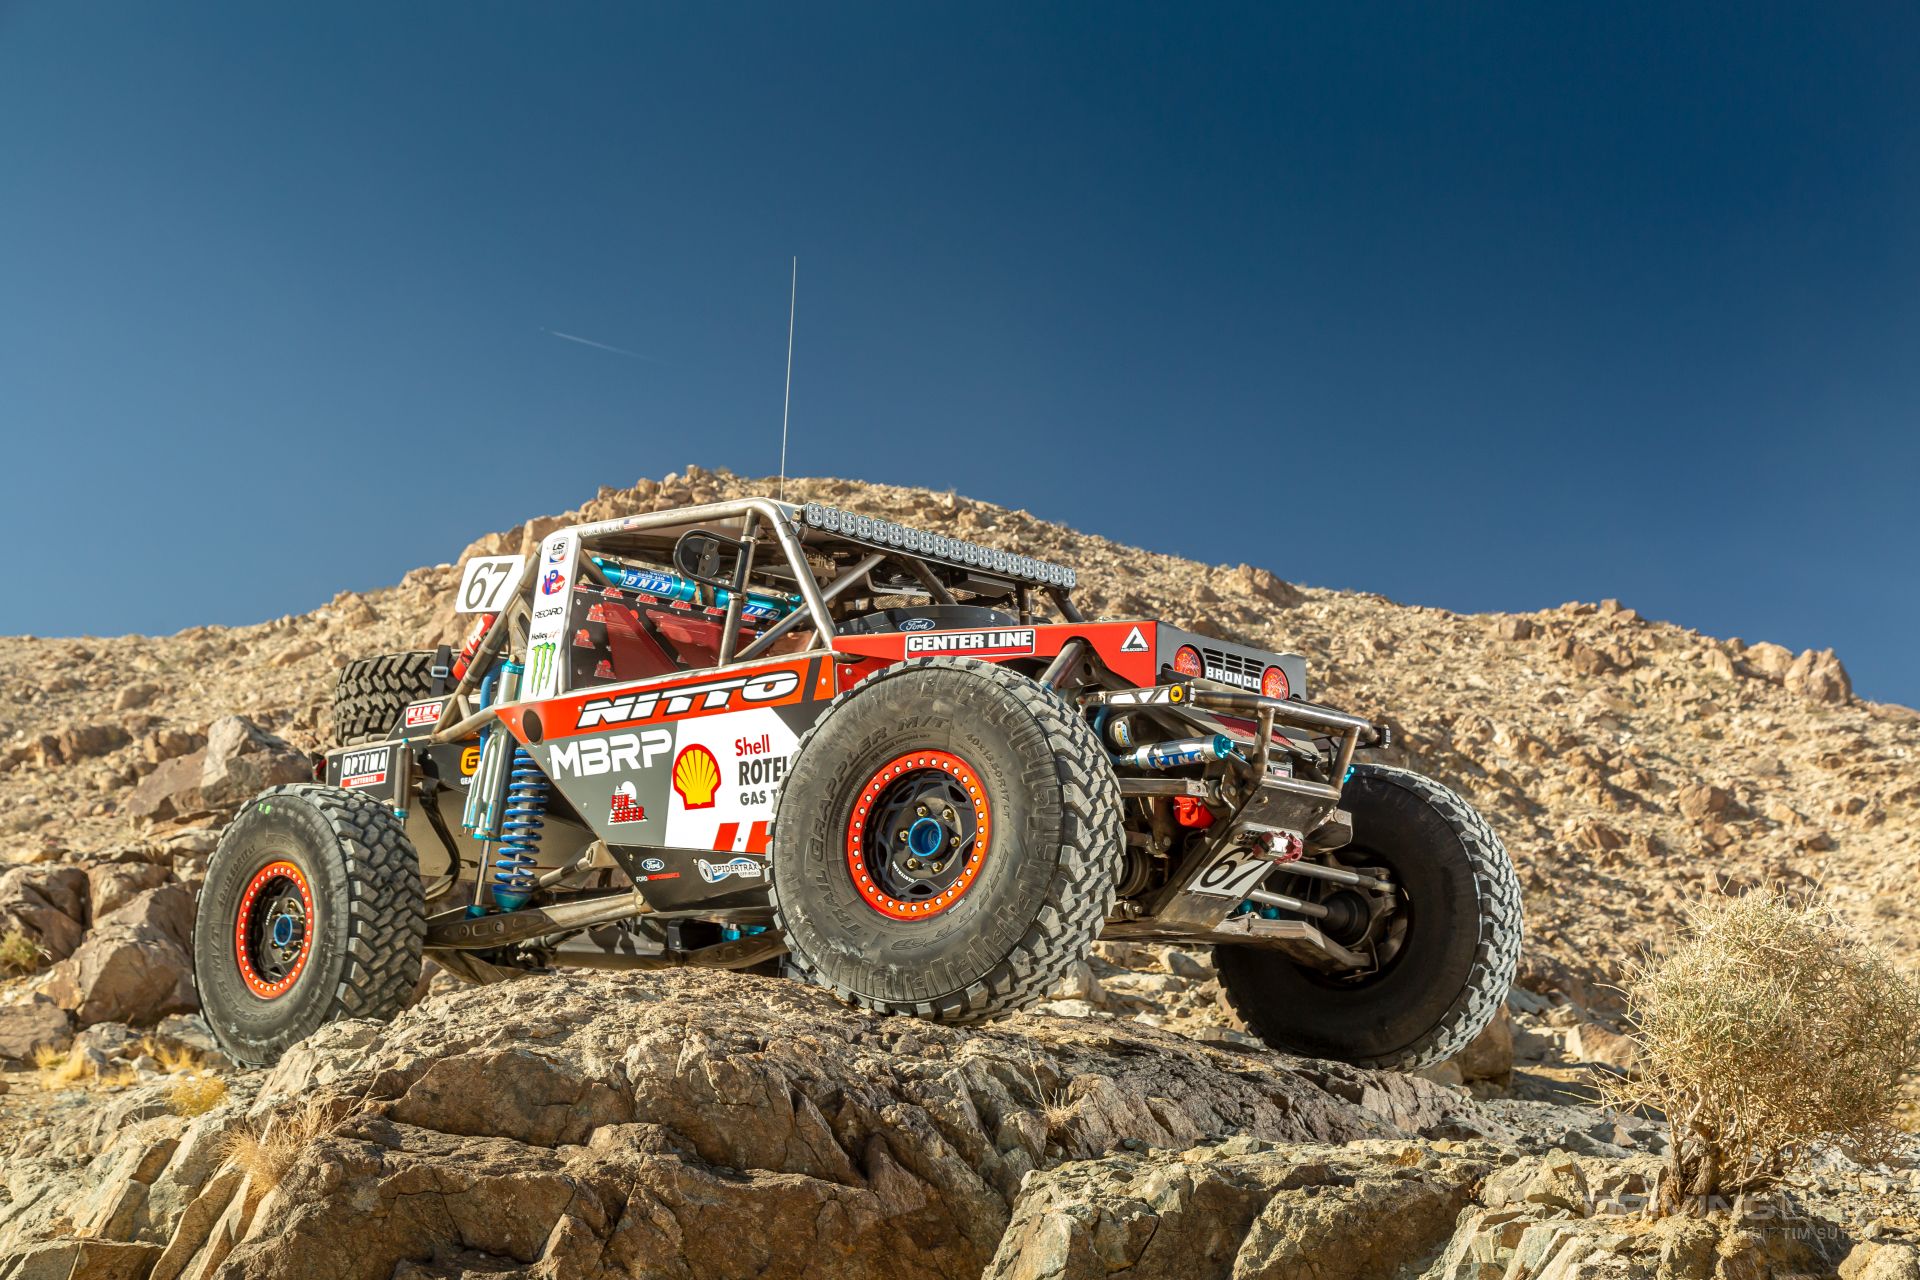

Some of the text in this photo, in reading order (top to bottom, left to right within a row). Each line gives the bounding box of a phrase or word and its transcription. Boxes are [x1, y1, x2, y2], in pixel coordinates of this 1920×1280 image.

[465, 562, 513, 610] 67
[625, 575, 671, 593] KING
[534, 606, 563, 619] RECARO
[742, 604, 781, 620] ING
[908, 631, 1032, 651] CENTER LINE
[1205, 665, 1261, 690] BRONCO
[575, 670, 800, 729] NITTO
[549, 728, 673, 780] MBRP
[735, 734, 770, 757] Shell
[343, 751, 387, 776] OPTIMA
[350, 774, 377, 785] BATTERIES
[809, 727, 888, 862] GRAPPLER
[897, 714, 950, 732] M/T
[740, 790, 767, 806] GAS
[713, 860, 758, 874] SPIDERTRAX
[1200, 845, 1267, 891] 67
